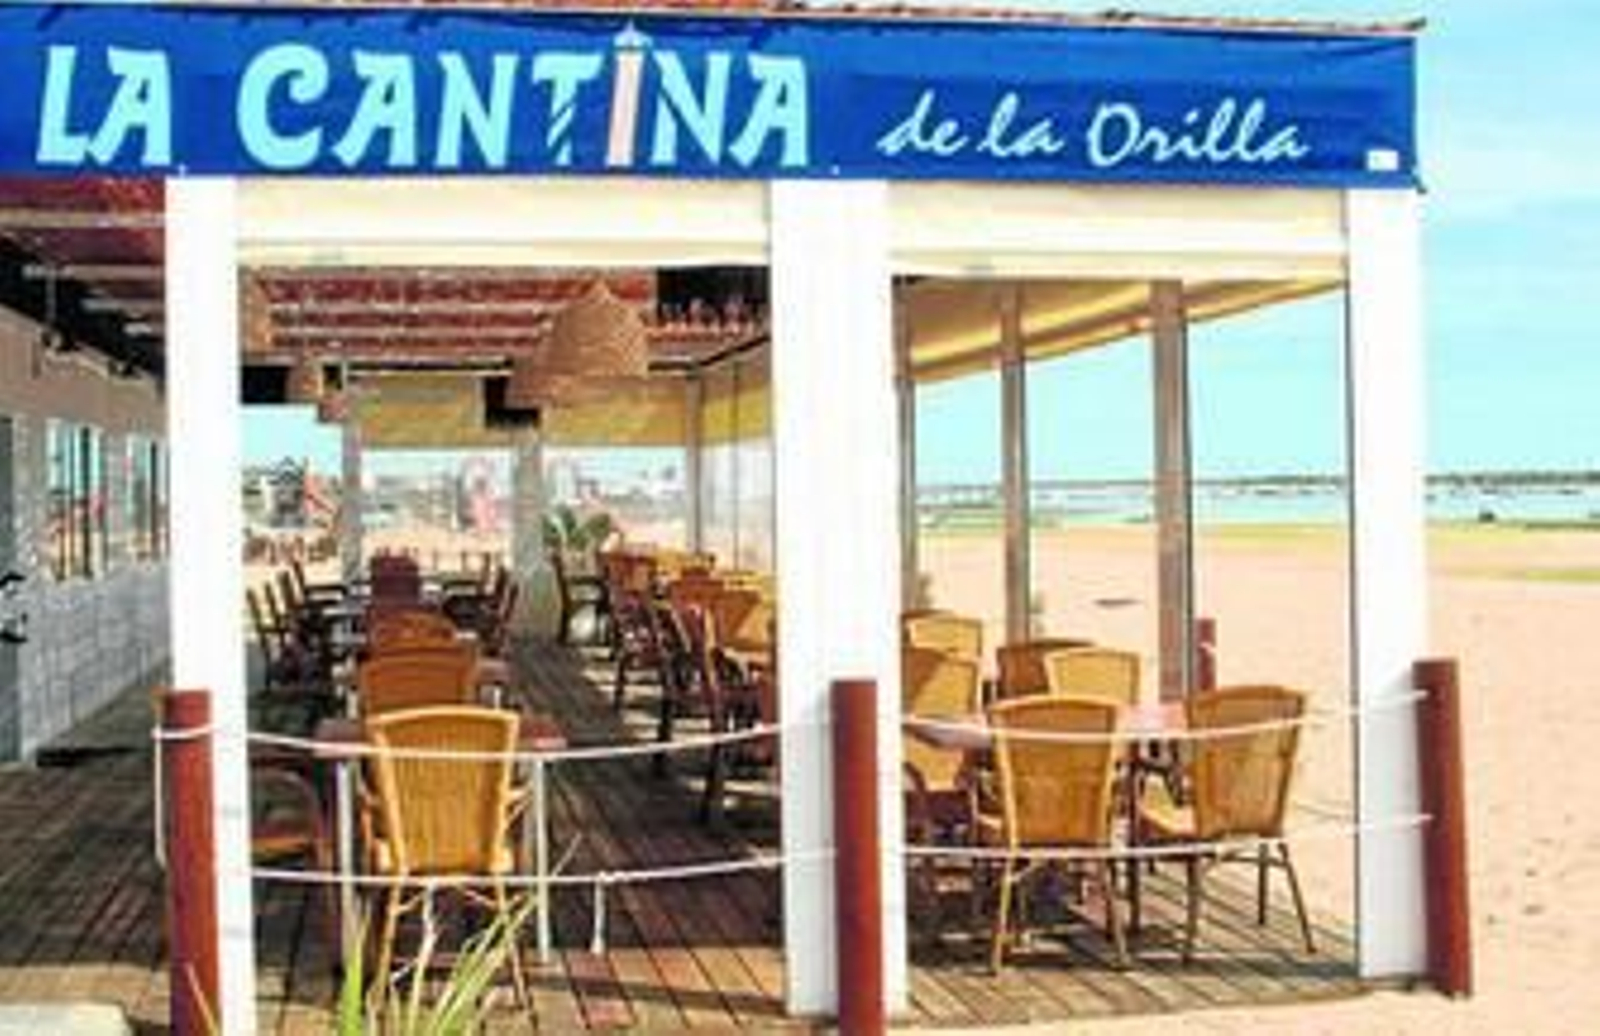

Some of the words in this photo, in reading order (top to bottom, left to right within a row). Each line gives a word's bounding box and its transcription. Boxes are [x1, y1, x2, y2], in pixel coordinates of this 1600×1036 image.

[36, 45, 172, 166] LA
[236, 27, 811, 168] CANTINA
[877, 89, 968, 156] de
[977, 92, 1064, 156] la
[1086, 97, 1309, 167] Orilla
